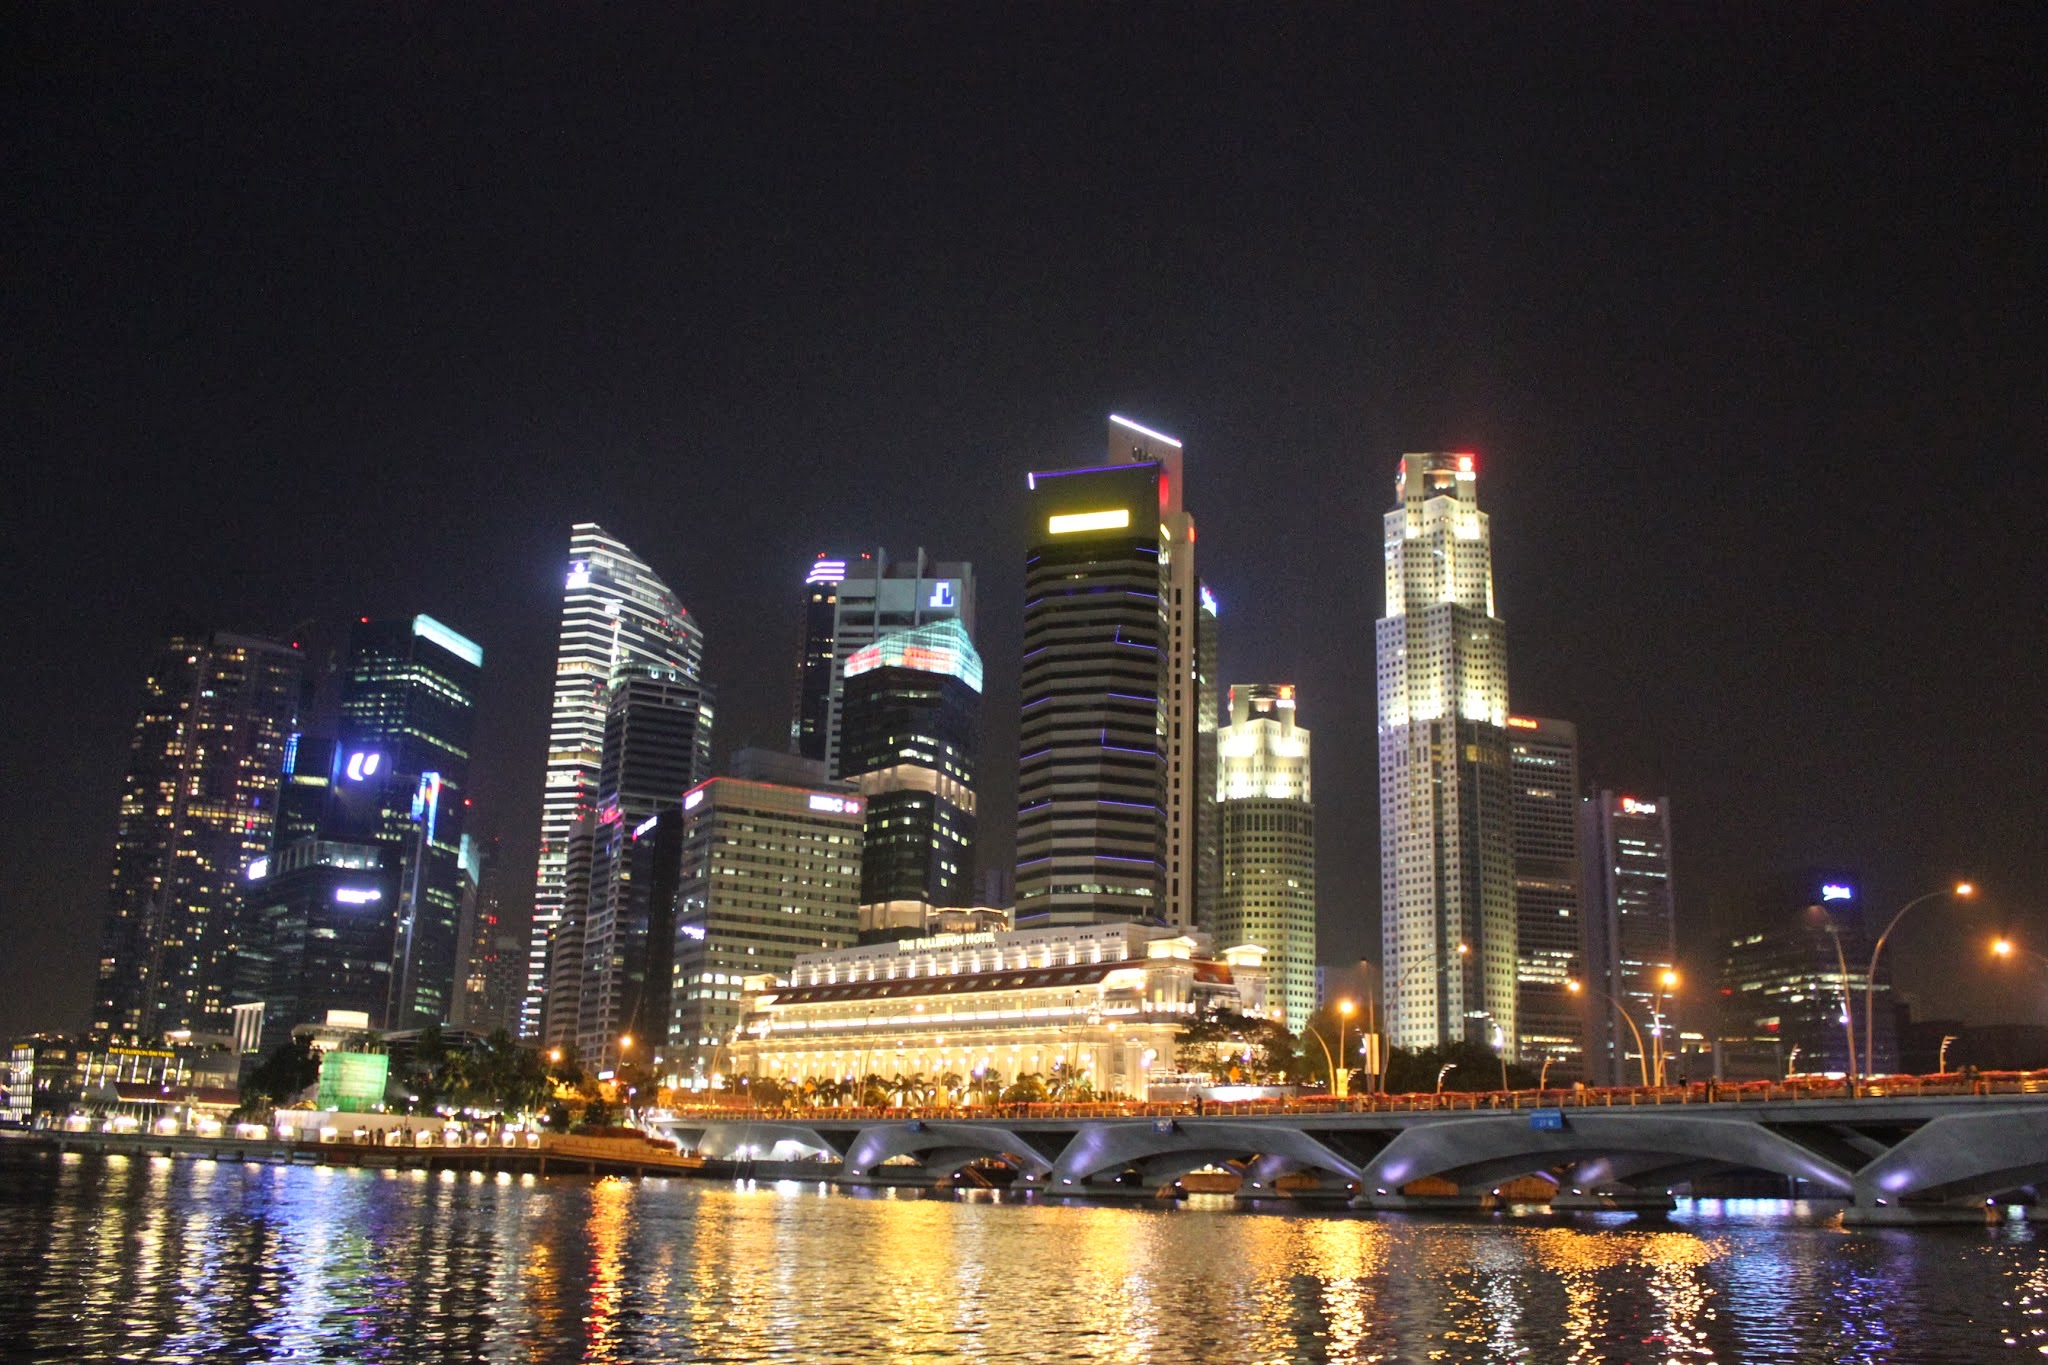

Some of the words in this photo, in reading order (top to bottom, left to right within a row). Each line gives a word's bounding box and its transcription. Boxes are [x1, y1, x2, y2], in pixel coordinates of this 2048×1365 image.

[899, 939, 915, 950] THE
[916, 934, 964, 949] FULLERTON
[965, 932, 995, 944] HOTEL
